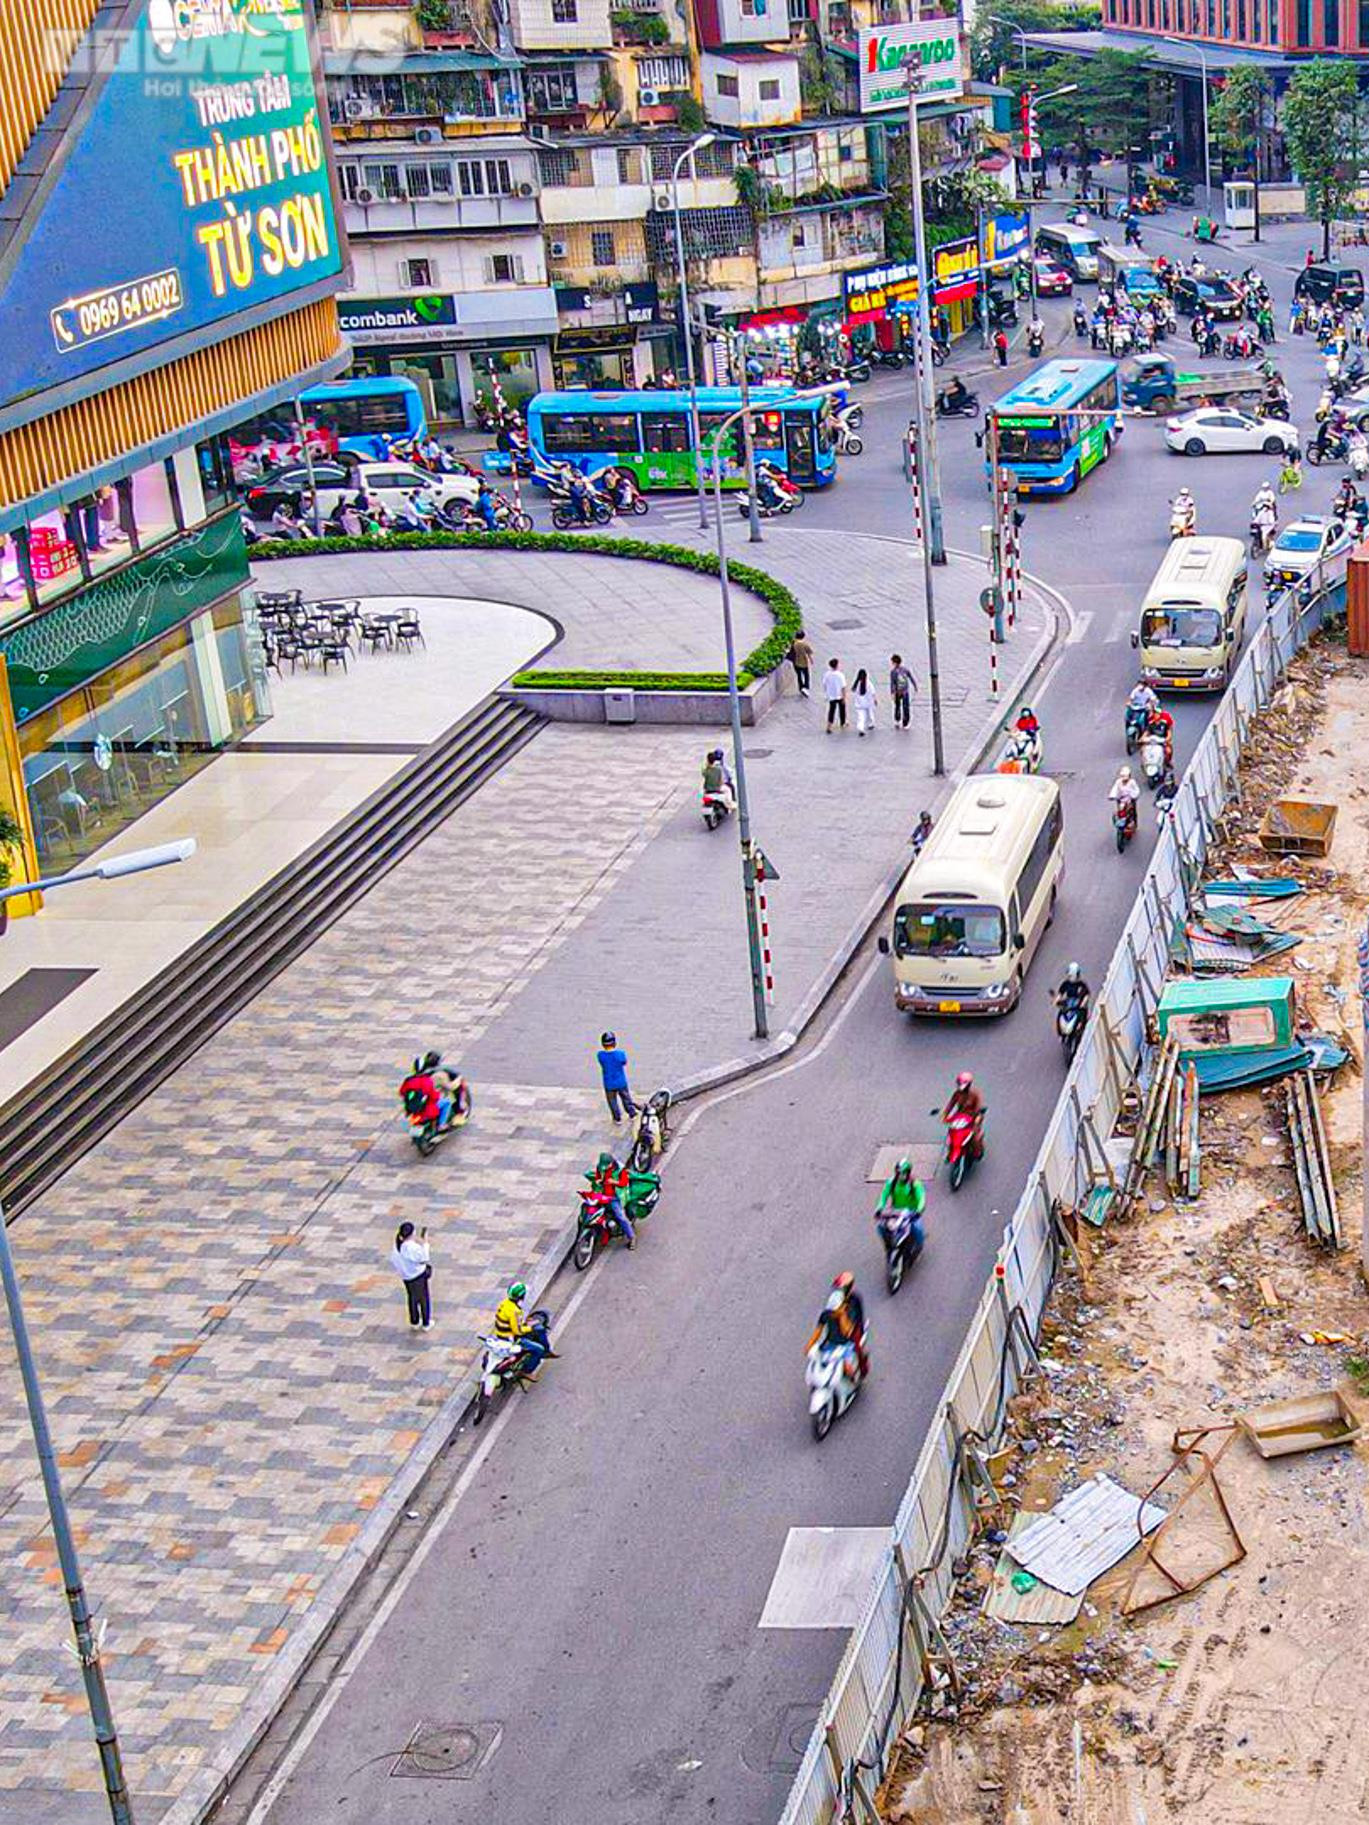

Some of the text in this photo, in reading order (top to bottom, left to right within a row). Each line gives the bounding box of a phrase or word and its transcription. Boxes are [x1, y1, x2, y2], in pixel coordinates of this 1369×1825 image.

[192, 81, 254, 126] TRUNG
[255, 69, 292, 114] TÂM
[173, 108, 321, 206] THÀNH PHỐ
[197, 191, 329, 296] TỪ SƠN
[80, 273, 179, 336] 0969 64 0002
[339, 309, 419, 328] combank
